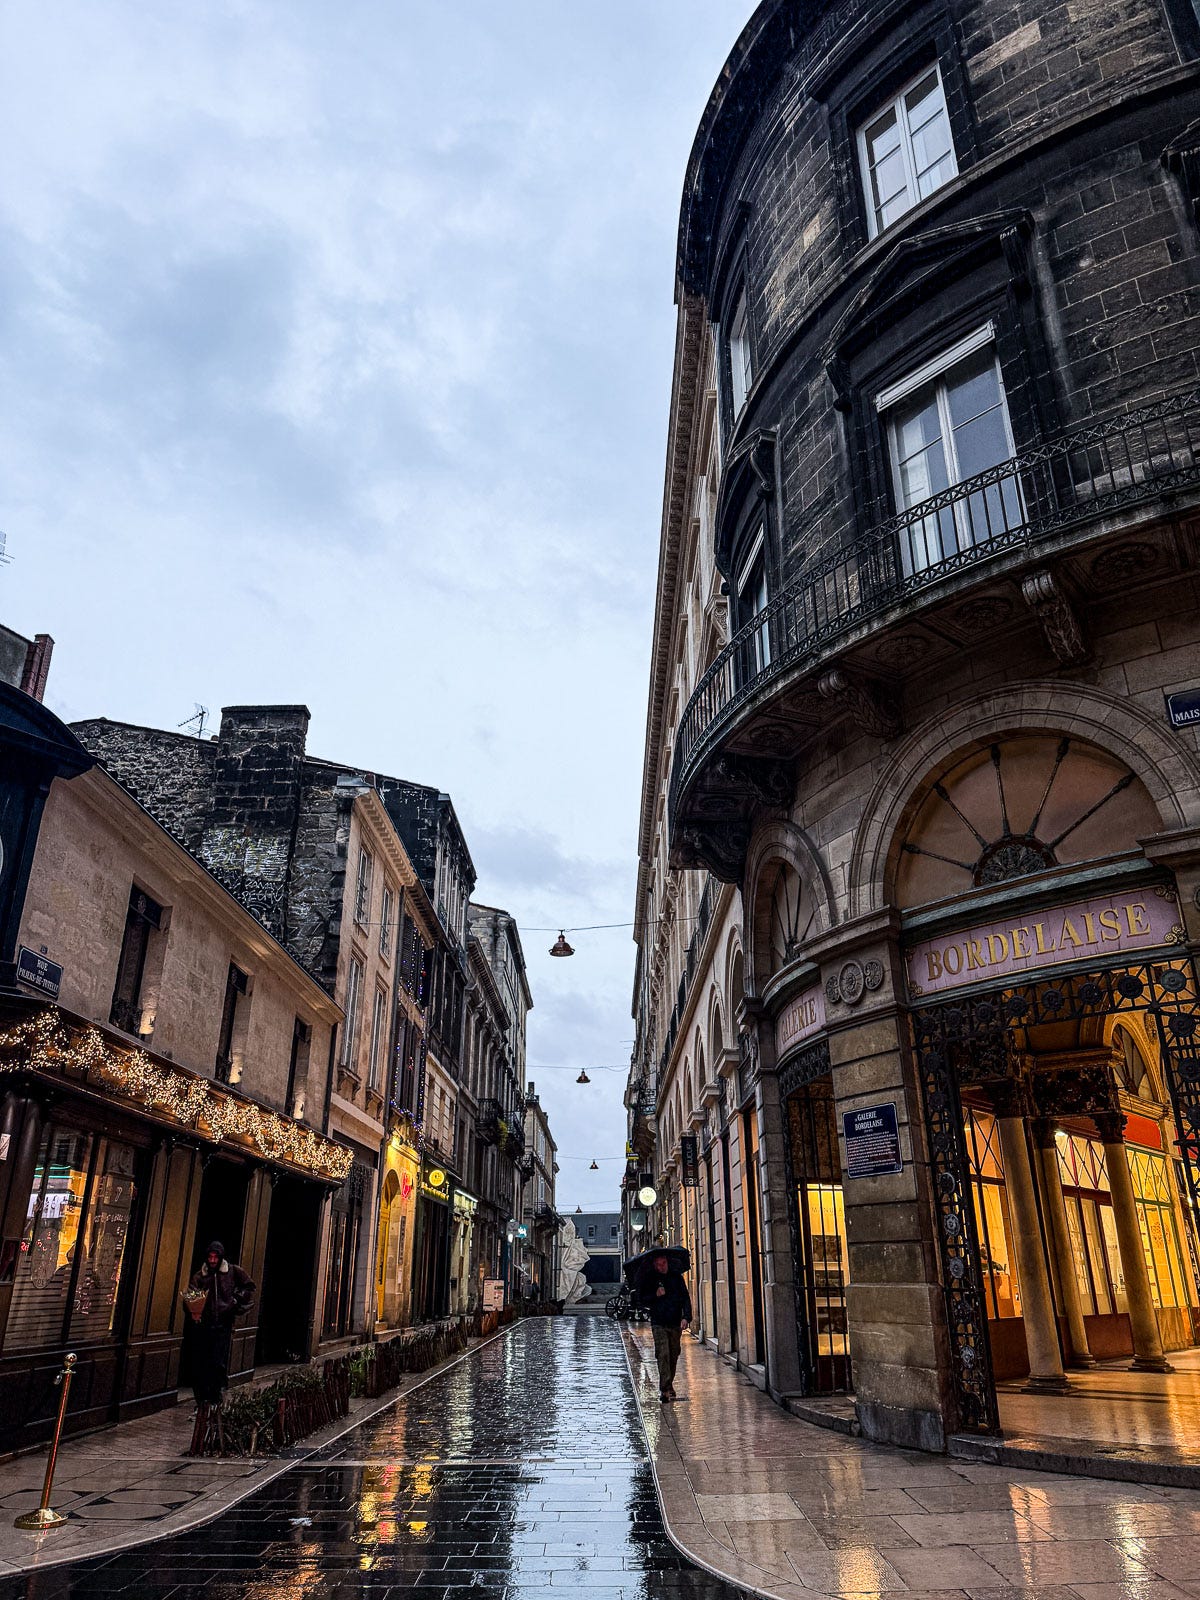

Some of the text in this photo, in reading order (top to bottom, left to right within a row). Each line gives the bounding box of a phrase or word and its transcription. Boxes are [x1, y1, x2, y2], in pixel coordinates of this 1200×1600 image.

[924, 903, 1151, 982] BORDELAISE
[36, 959, 49, 972] RUE
[781, 997, 817, 1045] GALERIE
[857, 1110, 877, 1122] GALERIE
[854, 1118, 884, 1132] BORDELAISE
